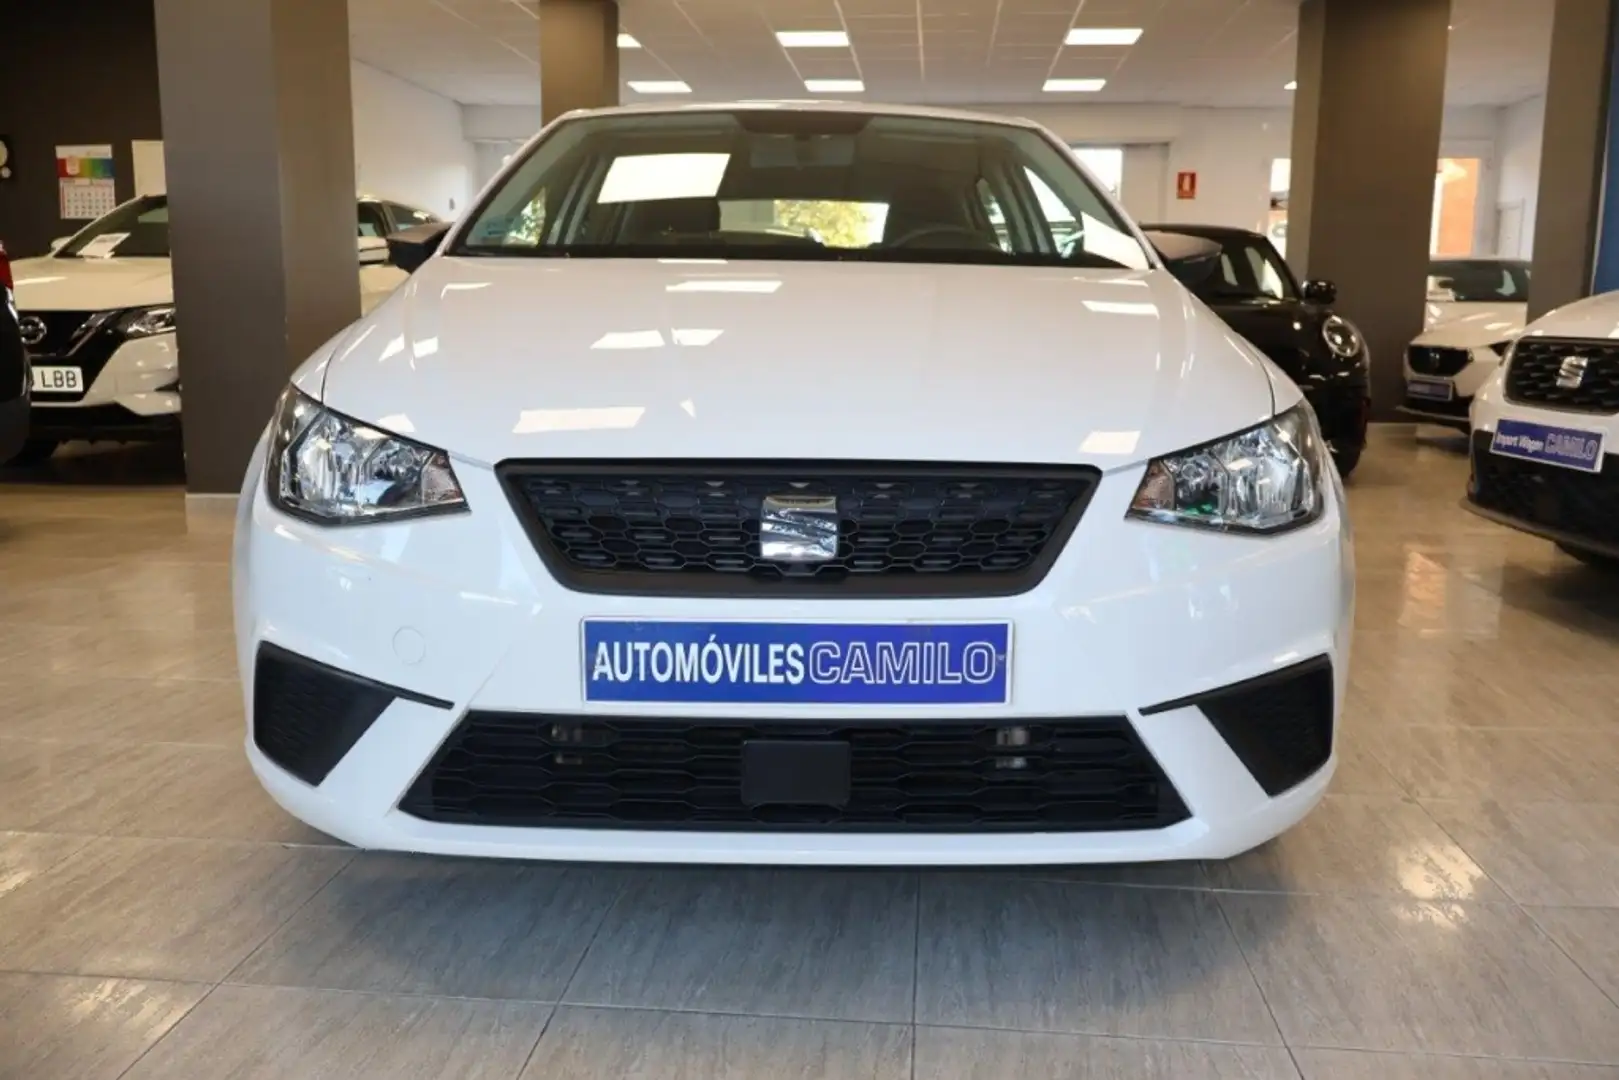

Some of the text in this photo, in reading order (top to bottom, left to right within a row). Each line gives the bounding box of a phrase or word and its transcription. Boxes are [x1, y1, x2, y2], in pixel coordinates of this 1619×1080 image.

[41, 370, 77, 388] LBB
[1545, 432, 1598, 460] CAMILO
[592, 634, 997, 684] AUTOMÓVILES CAMILO
